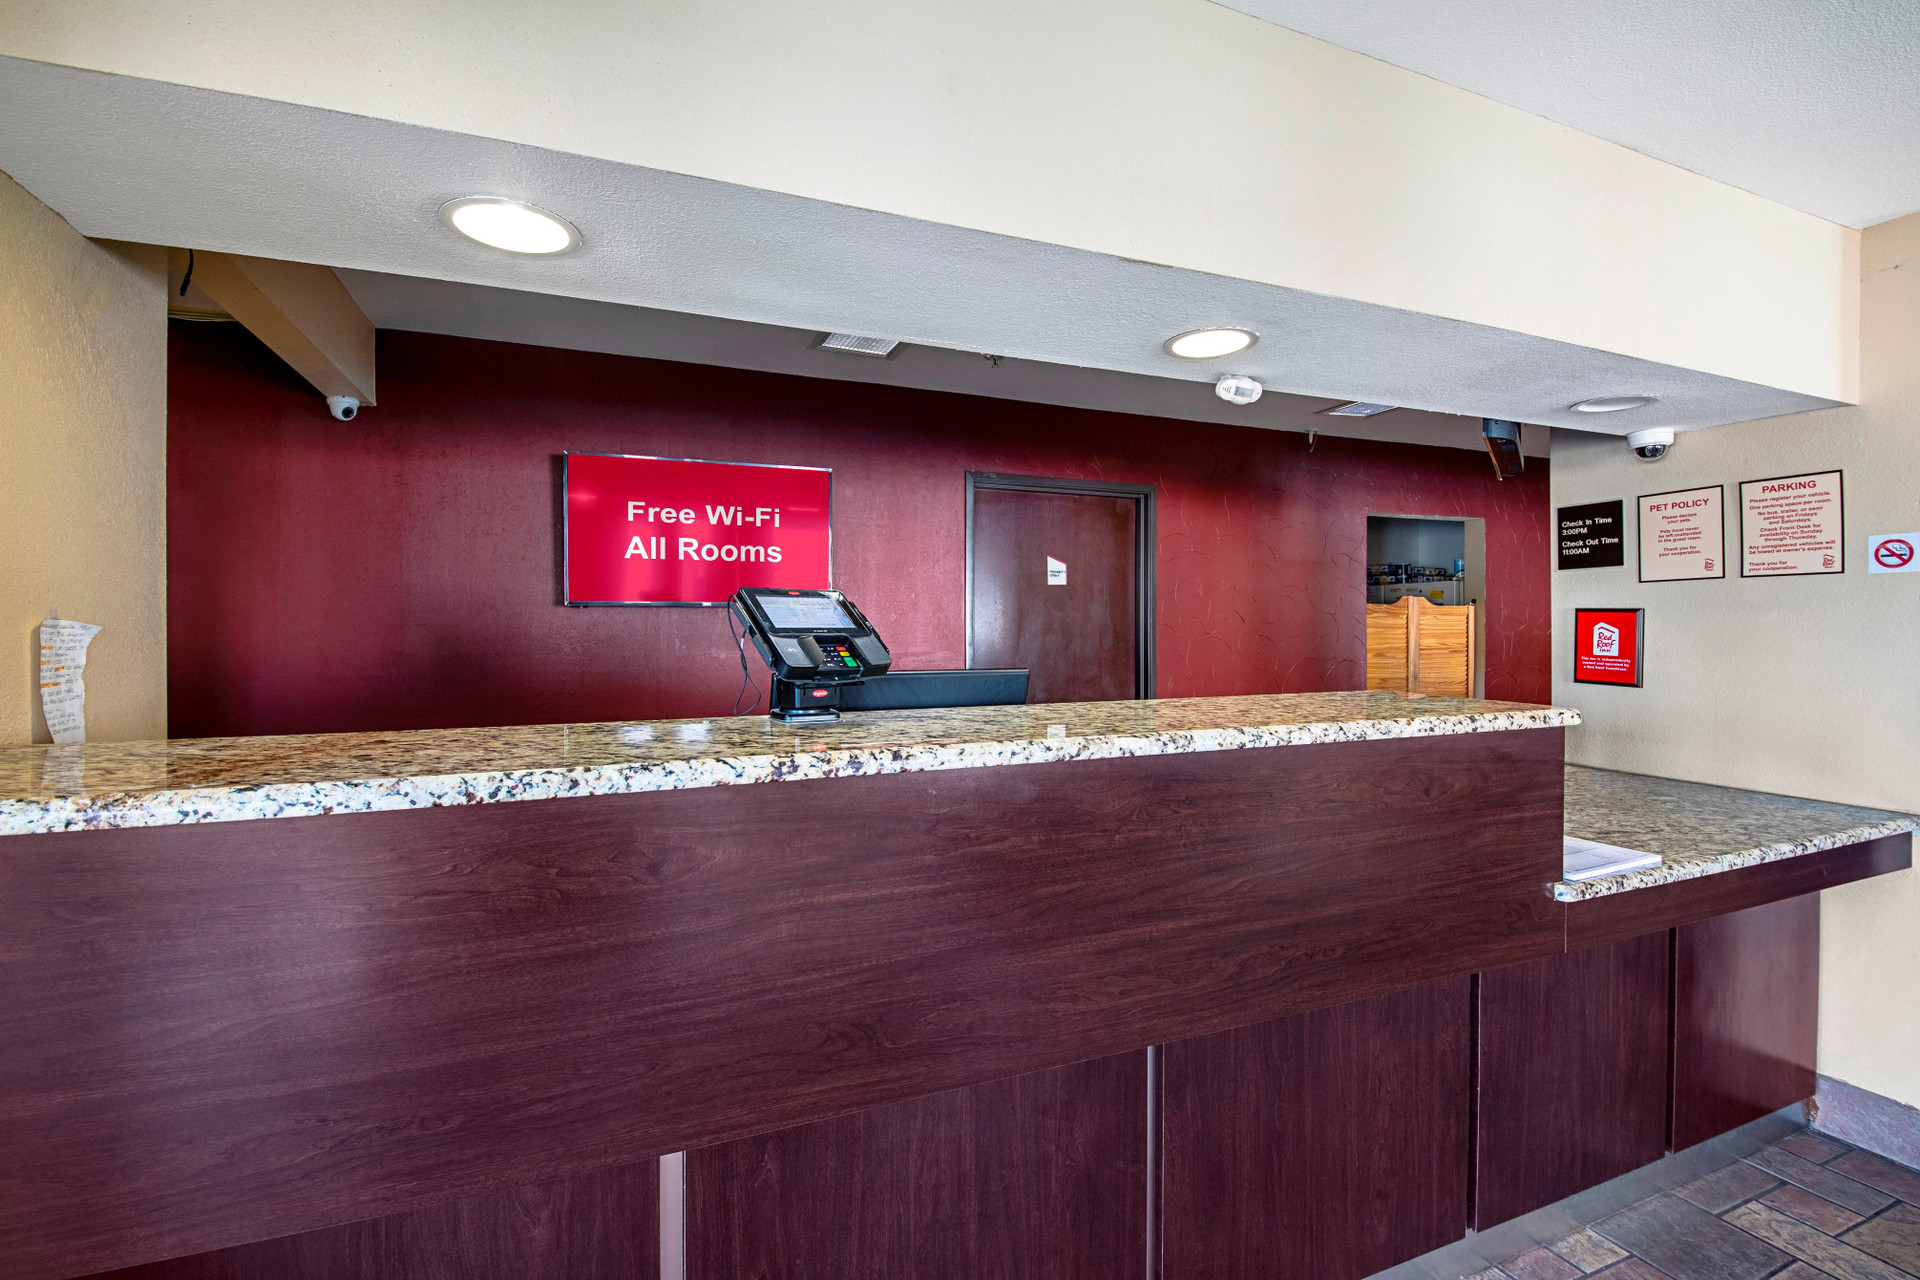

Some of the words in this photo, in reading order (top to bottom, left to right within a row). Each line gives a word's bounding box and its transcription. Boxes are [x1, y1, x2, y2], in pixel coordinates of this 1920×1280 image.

[1762, 480, 1816, 493] PARKING
[1650, 503, 1668, 512] PET
[1672, 498, 1709, 509] POLICY
[628, 501, 695, 524] Free
[706, 505, 780, 527] Wi-Fi
[1562, 527, 1587, 535] 3:00PM
[624, 536, 666, 559] All
[678, 538, 782, 563] Rooms
[1599, 632, 1613, 640] Red
[1597, 640, 1616, 649] Roof
